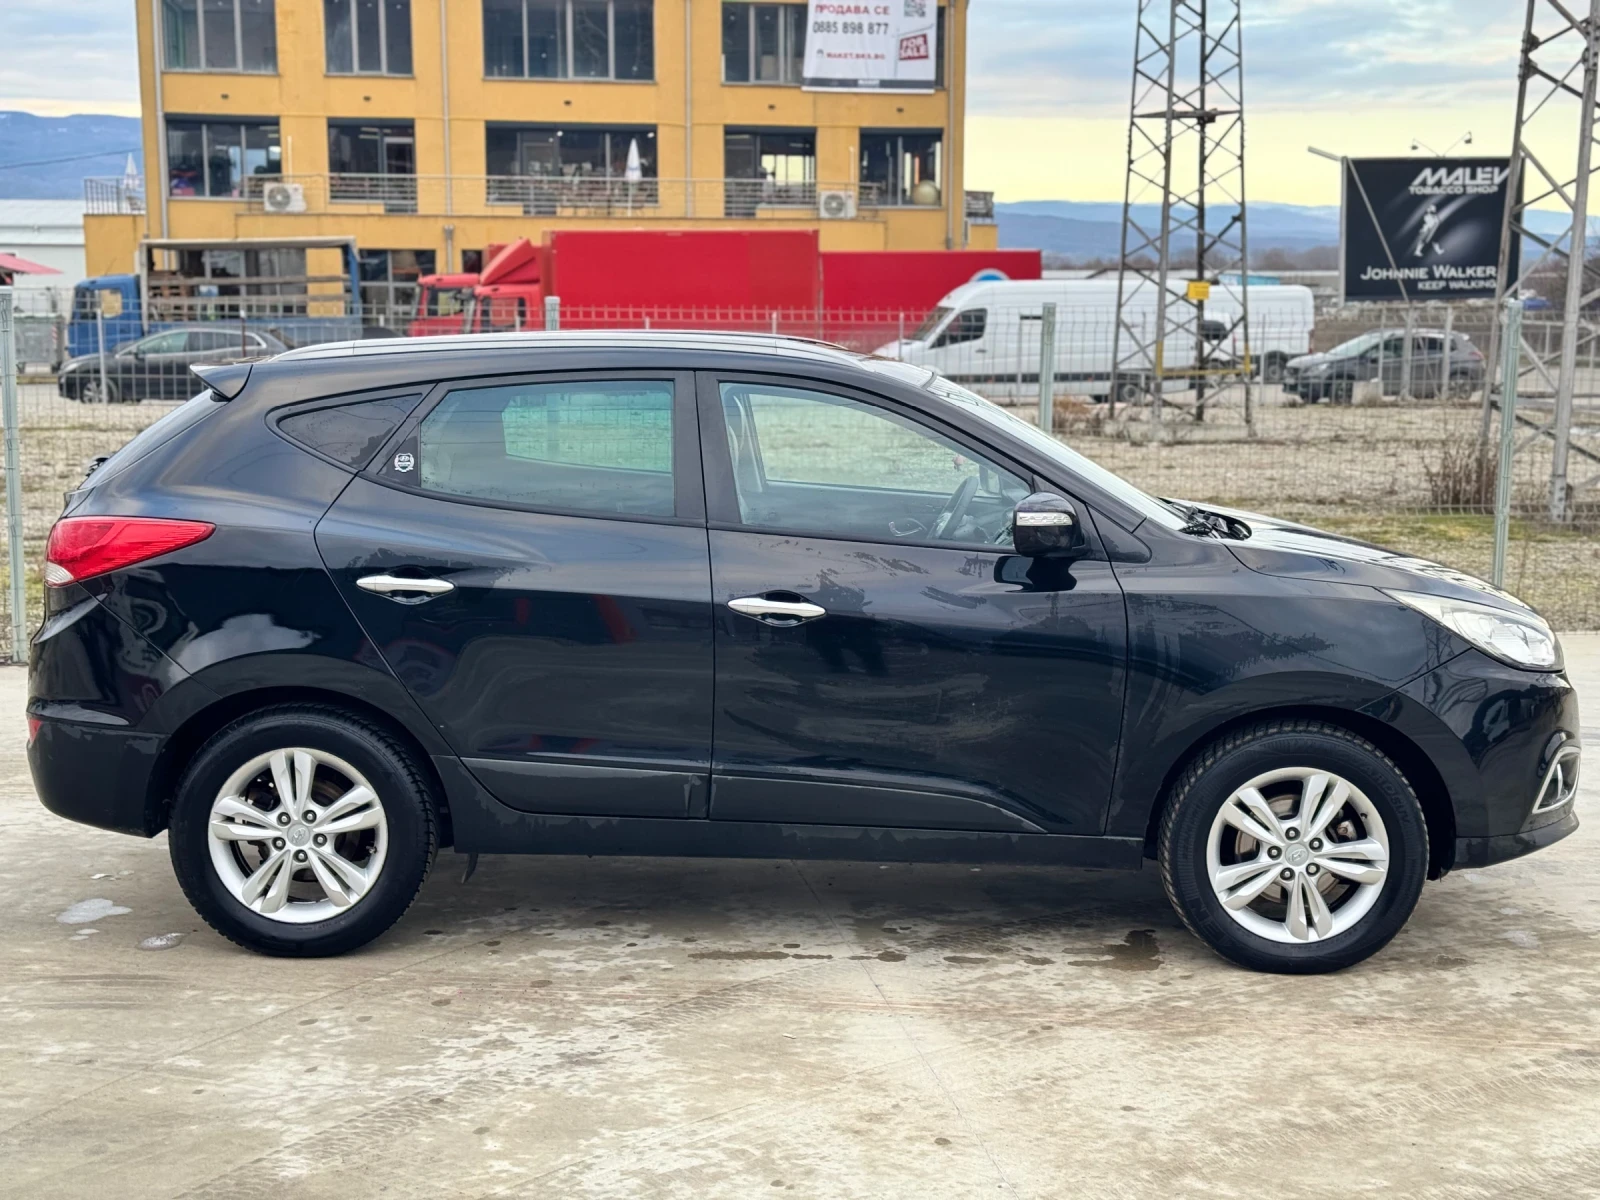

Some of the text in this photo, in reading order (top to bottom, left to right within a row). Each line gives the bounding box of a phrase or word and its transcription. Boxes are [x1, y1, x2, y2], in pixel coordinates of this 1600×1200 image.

[815, 4, 869, 15] ПРОДАВА
[813, 21, 889, 35] 0885 898 877
[902, 37, 924, 48] FOR
[900, 45, 928, 57] SALE
[1412, 167, 1510, 185] MALEV
[1408, 185, 1499, 195] TOBACCO SHOP
[1360, 264, 1497, 280] JOHNNIE WALKER
[1417, 280, 1497, 290] KEEP WALKING
